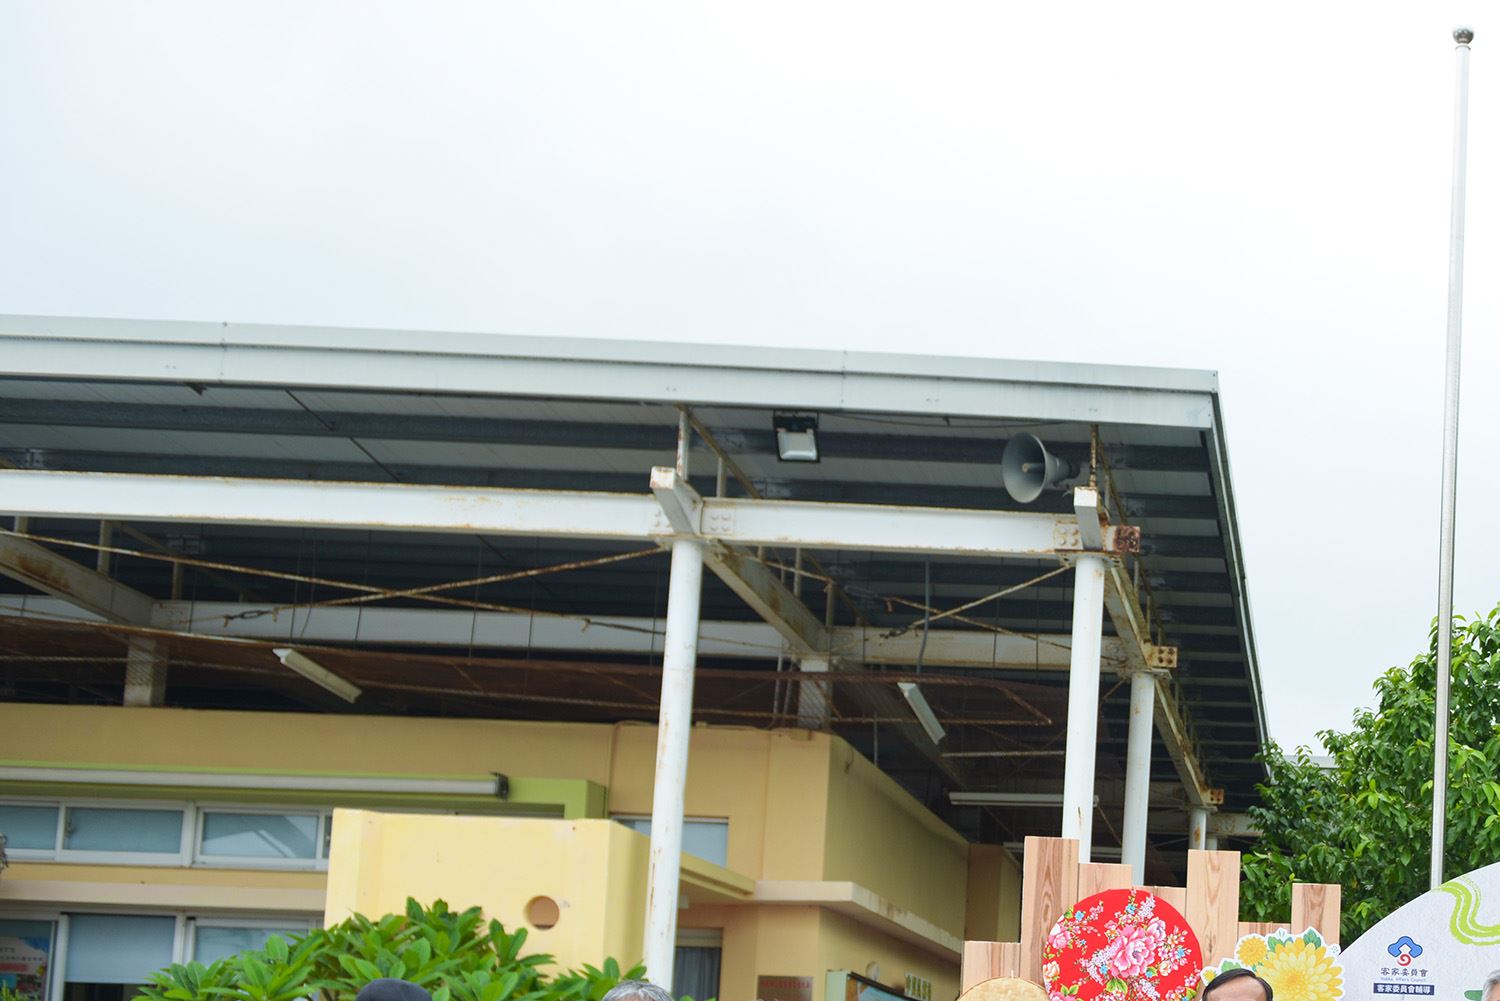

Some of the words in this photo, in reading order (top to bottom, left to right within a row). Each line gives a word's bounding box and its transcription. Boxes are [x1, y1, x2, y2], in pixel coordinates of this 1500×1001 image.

[1380, 967, 1428, 977] 客家委員會
